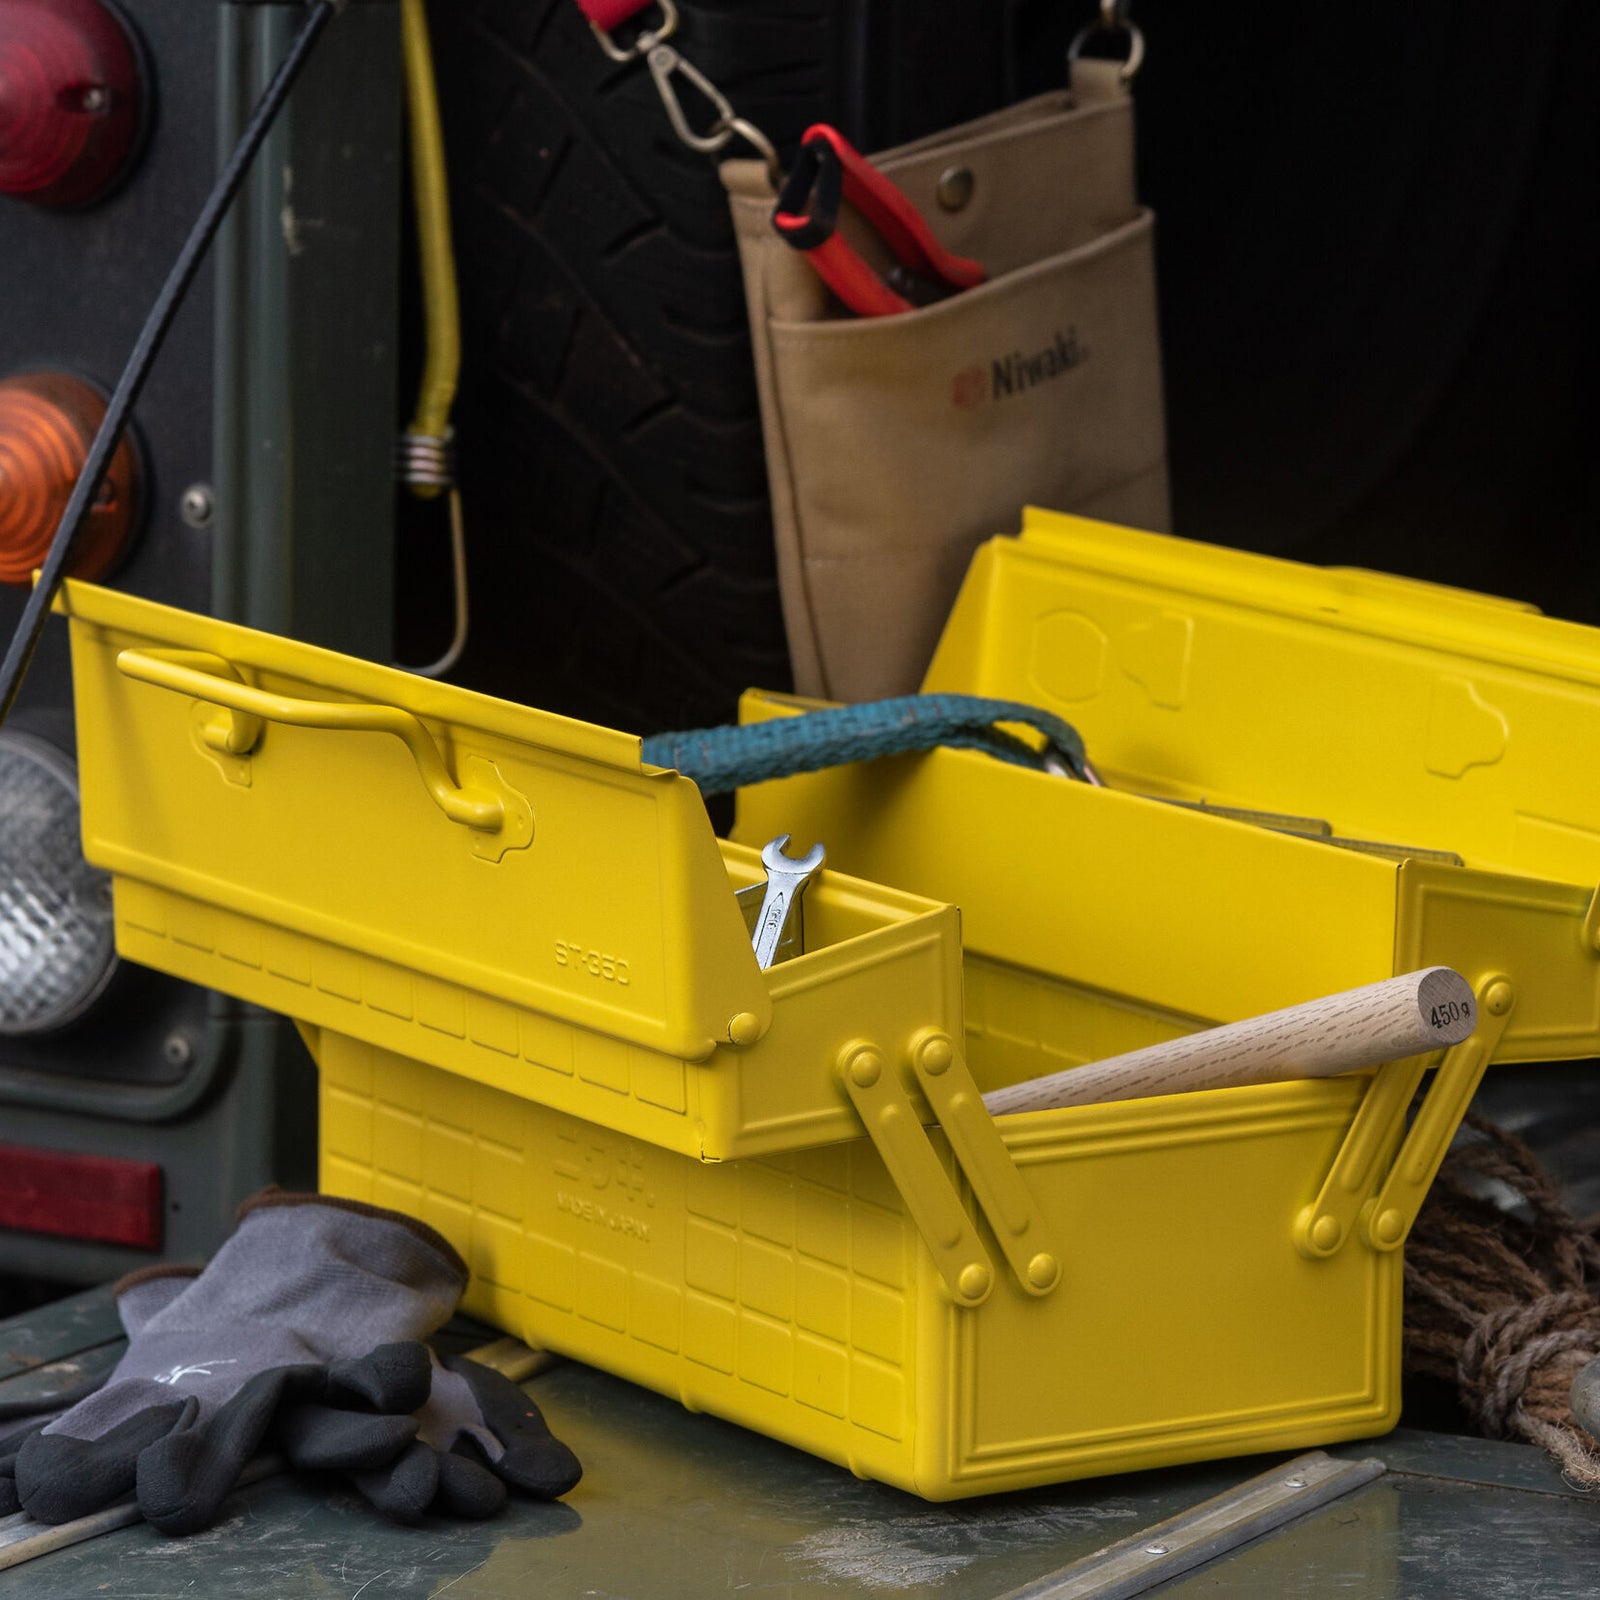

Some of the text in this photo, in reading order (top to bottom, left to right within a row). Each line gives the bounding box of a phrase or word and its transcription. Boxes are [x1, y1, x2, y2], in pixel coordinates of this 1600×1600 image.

[554, 939, 630, 987] ST-350
[556, 1190, 593, 1223] MADE
[609, 1213, 652, 1244] JAPAN
